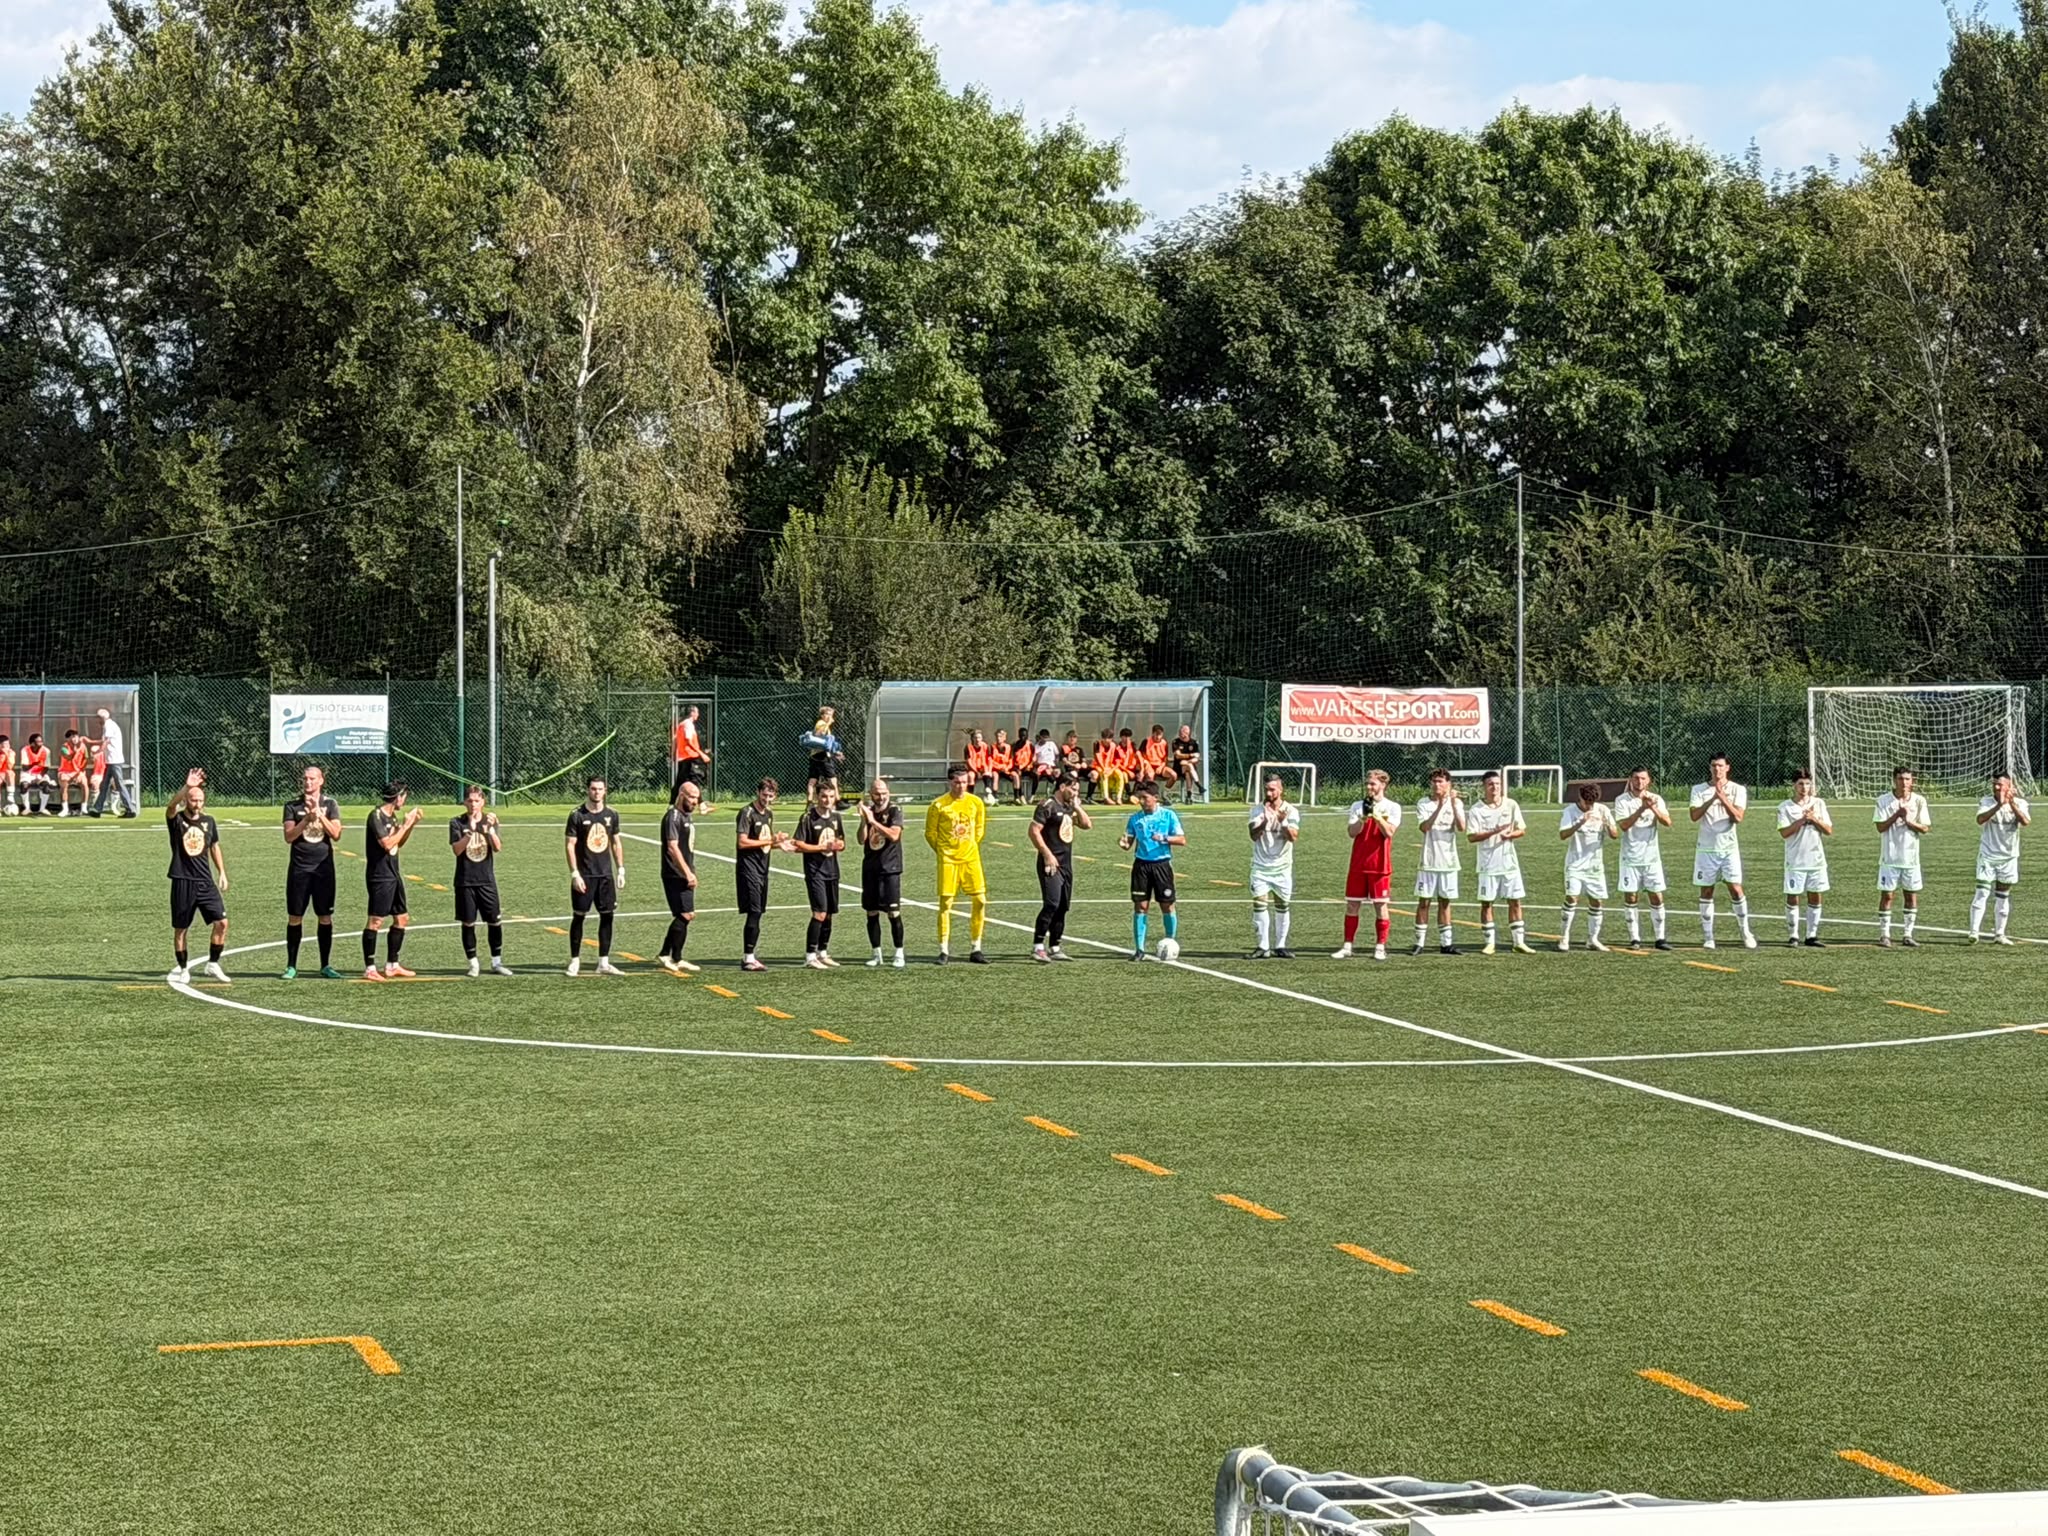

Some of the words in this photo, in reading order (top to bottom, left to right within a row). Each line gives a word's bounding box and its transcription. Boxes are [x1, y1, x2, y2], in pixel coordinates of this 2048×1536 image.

[1290, 698, 1479, 720] www.VARESESPORT.com
[1289, 725, 1333, 738] TUTTO
[1337, 726, 1353, 738] LO
[1357, 727, 1399, 739] SPORT
[1403, 728, 1416, 739] IN
[1420, 729, 1439, 740] UN
[1443, 729, 1481, 740] CLICK
